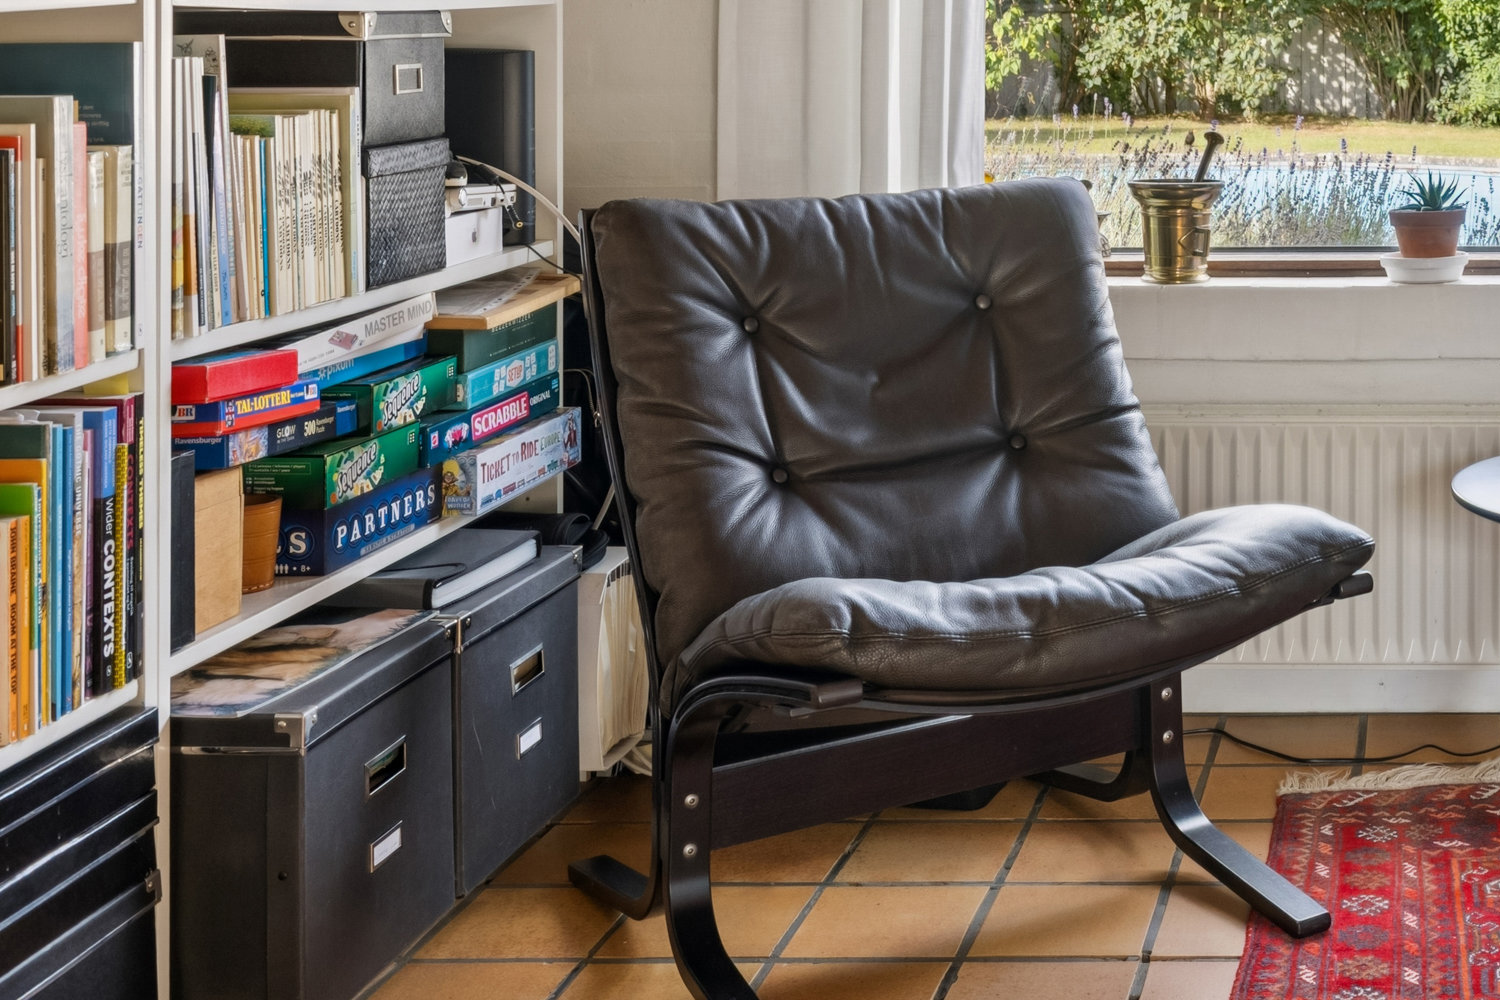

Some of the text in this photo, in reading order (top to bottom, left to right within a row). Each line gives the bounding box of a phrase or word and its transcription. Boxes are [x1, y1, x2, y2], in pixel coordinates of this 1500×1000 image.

[57, 190, 73, 259] antologi
[364, 299, 433, 338] MASTER MIND
[382, 371, 421, 428] Sequence
[473, 388, 552, 437] SCRABBLE ORIGINAL
[174, 436, 222, 447] Ravensburger
[276, 425, 297, 439] GLOW
[303, 419, 317, 438] 500
[335, 441, 379, 500] Sequence
[480, 430, 562, 485] TICKET TO RIDE EUROPE
[127, 454, 135, 550] CONTEXTS
[336, 482, 436, 551] PARTNERS
[102, 498, 115, 658] Wider CONTEXTS
[300, 563, 311, 573] 8+
[10, 633, 17, 646] AT
